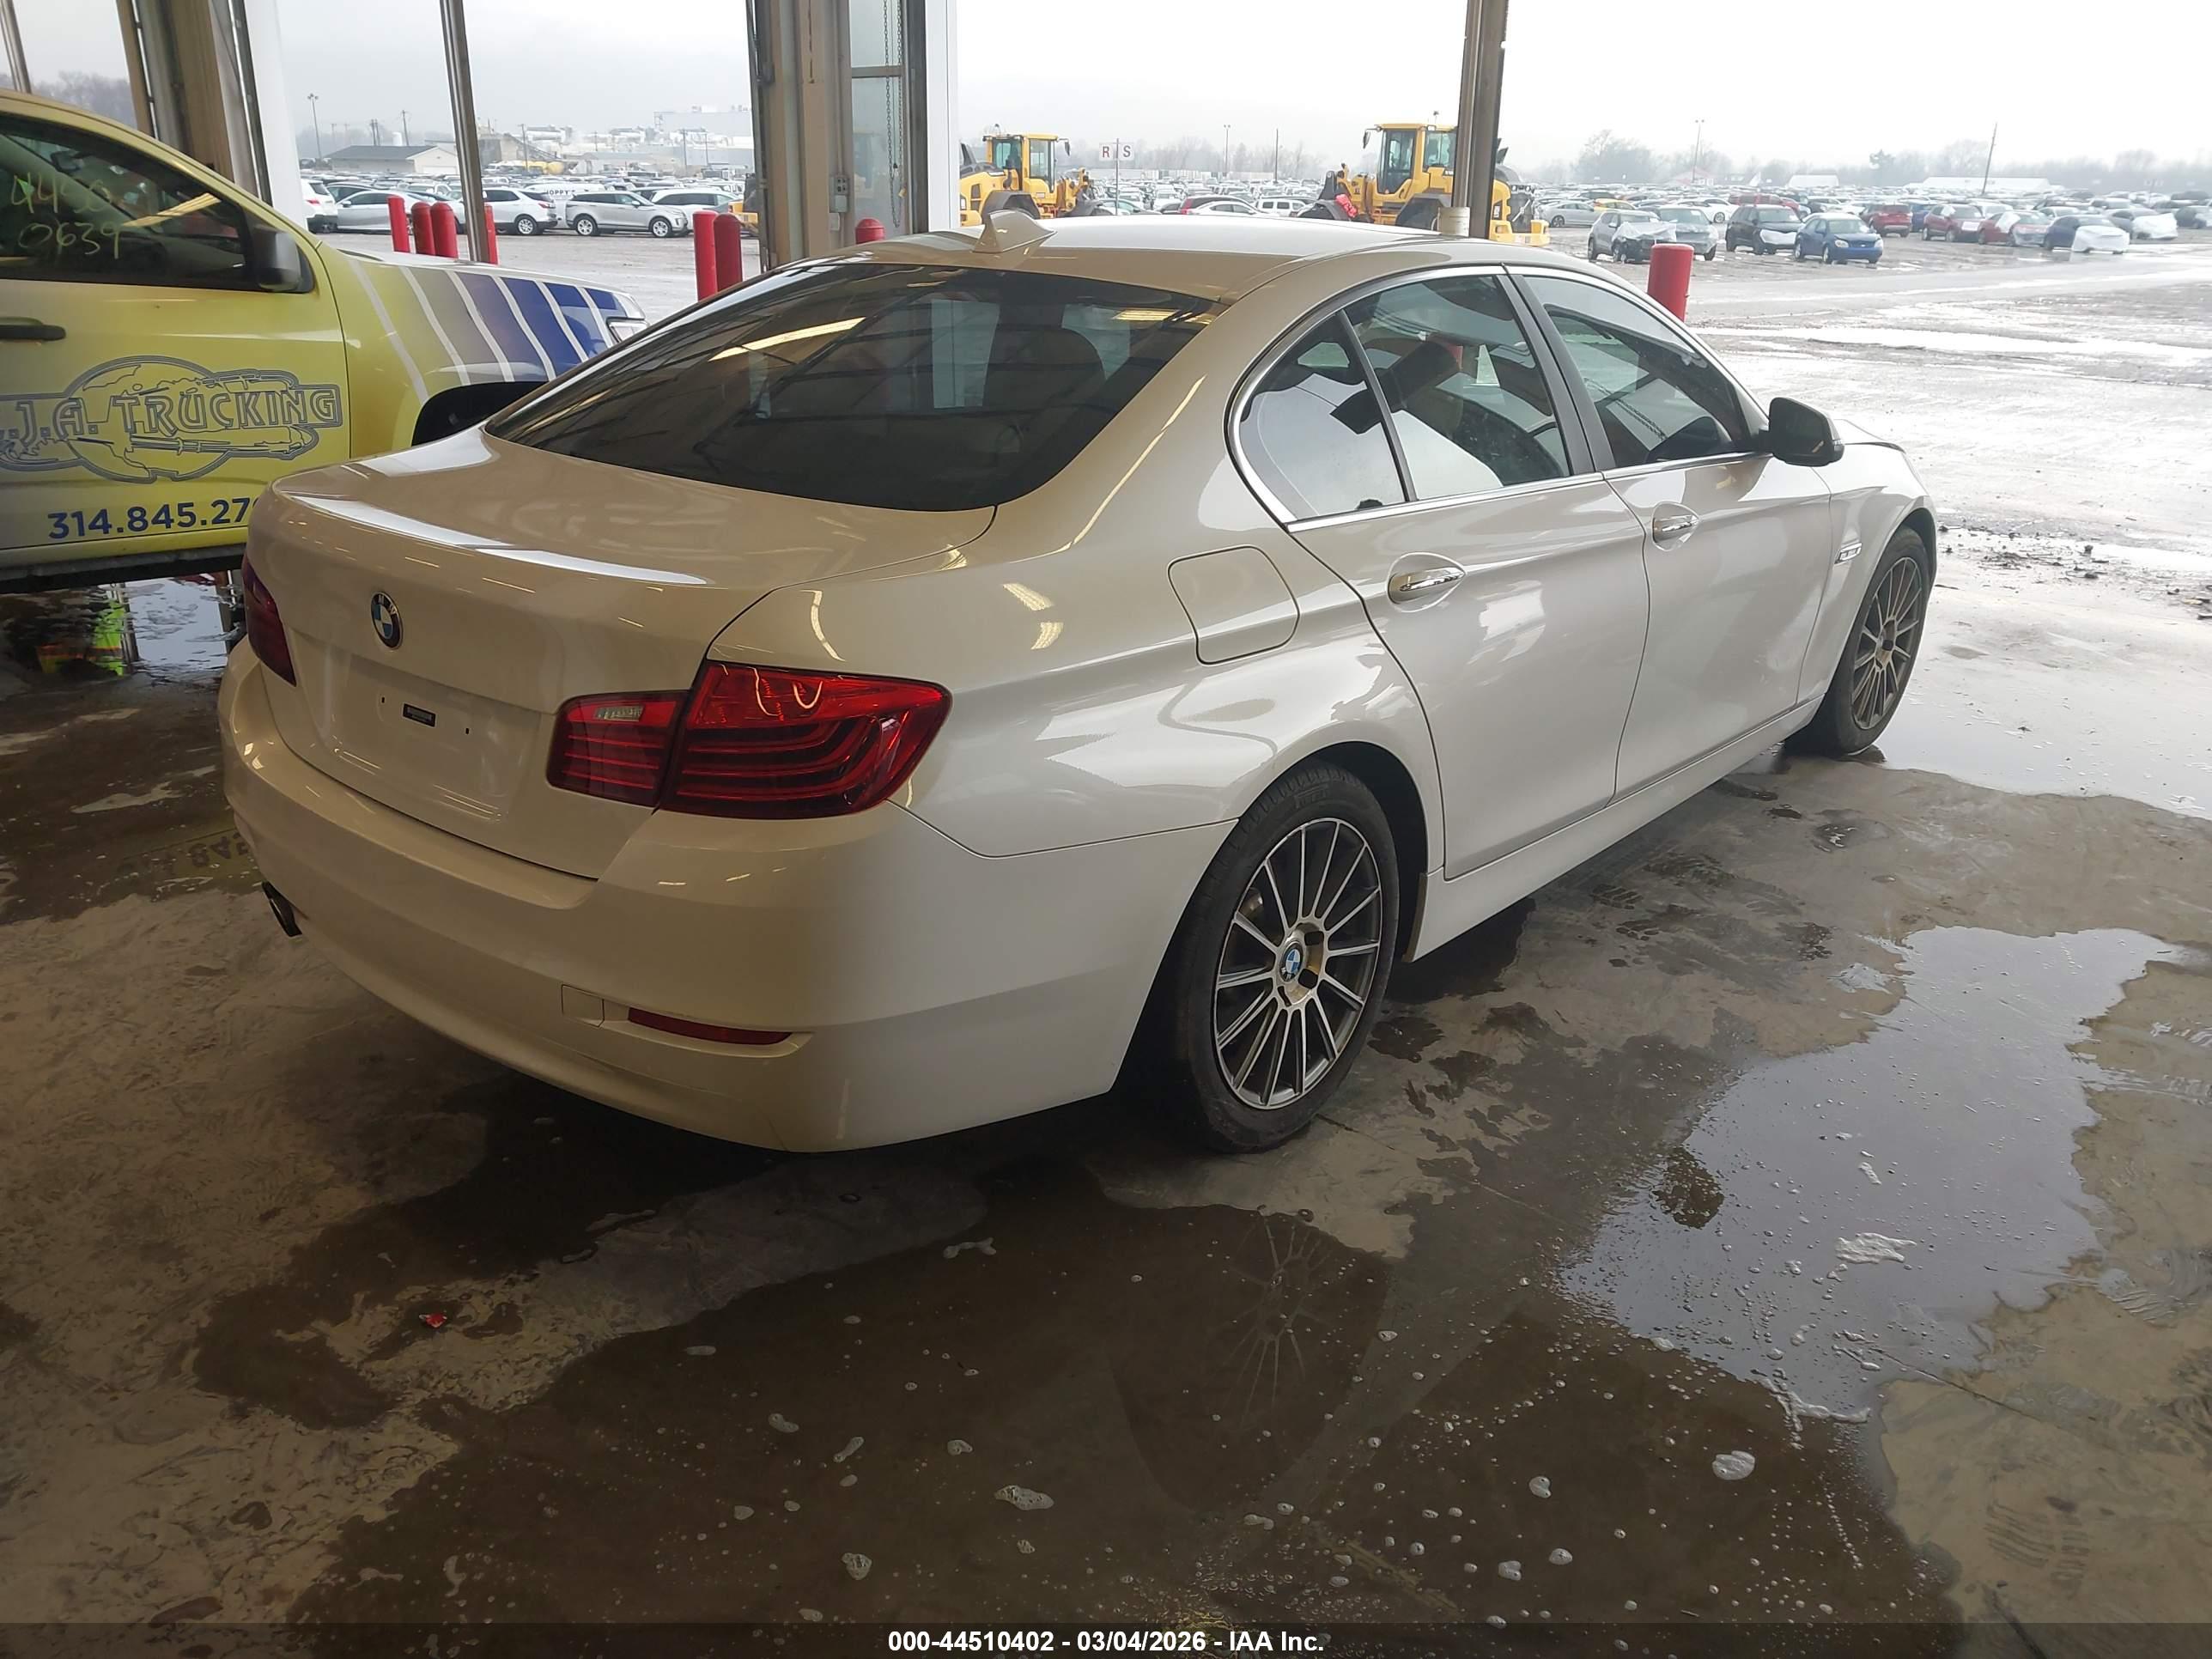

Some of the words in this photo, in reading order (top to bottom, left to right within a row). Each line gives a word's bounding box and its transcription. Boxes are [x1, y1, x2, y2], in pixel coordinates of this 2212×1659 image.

[1102, 145, 1110, 158] R
[1122, 145, 1131, 158] S
[112, 386, 338, 437] TRUCKING
[47, 497, 259, 540] 314.845.27
